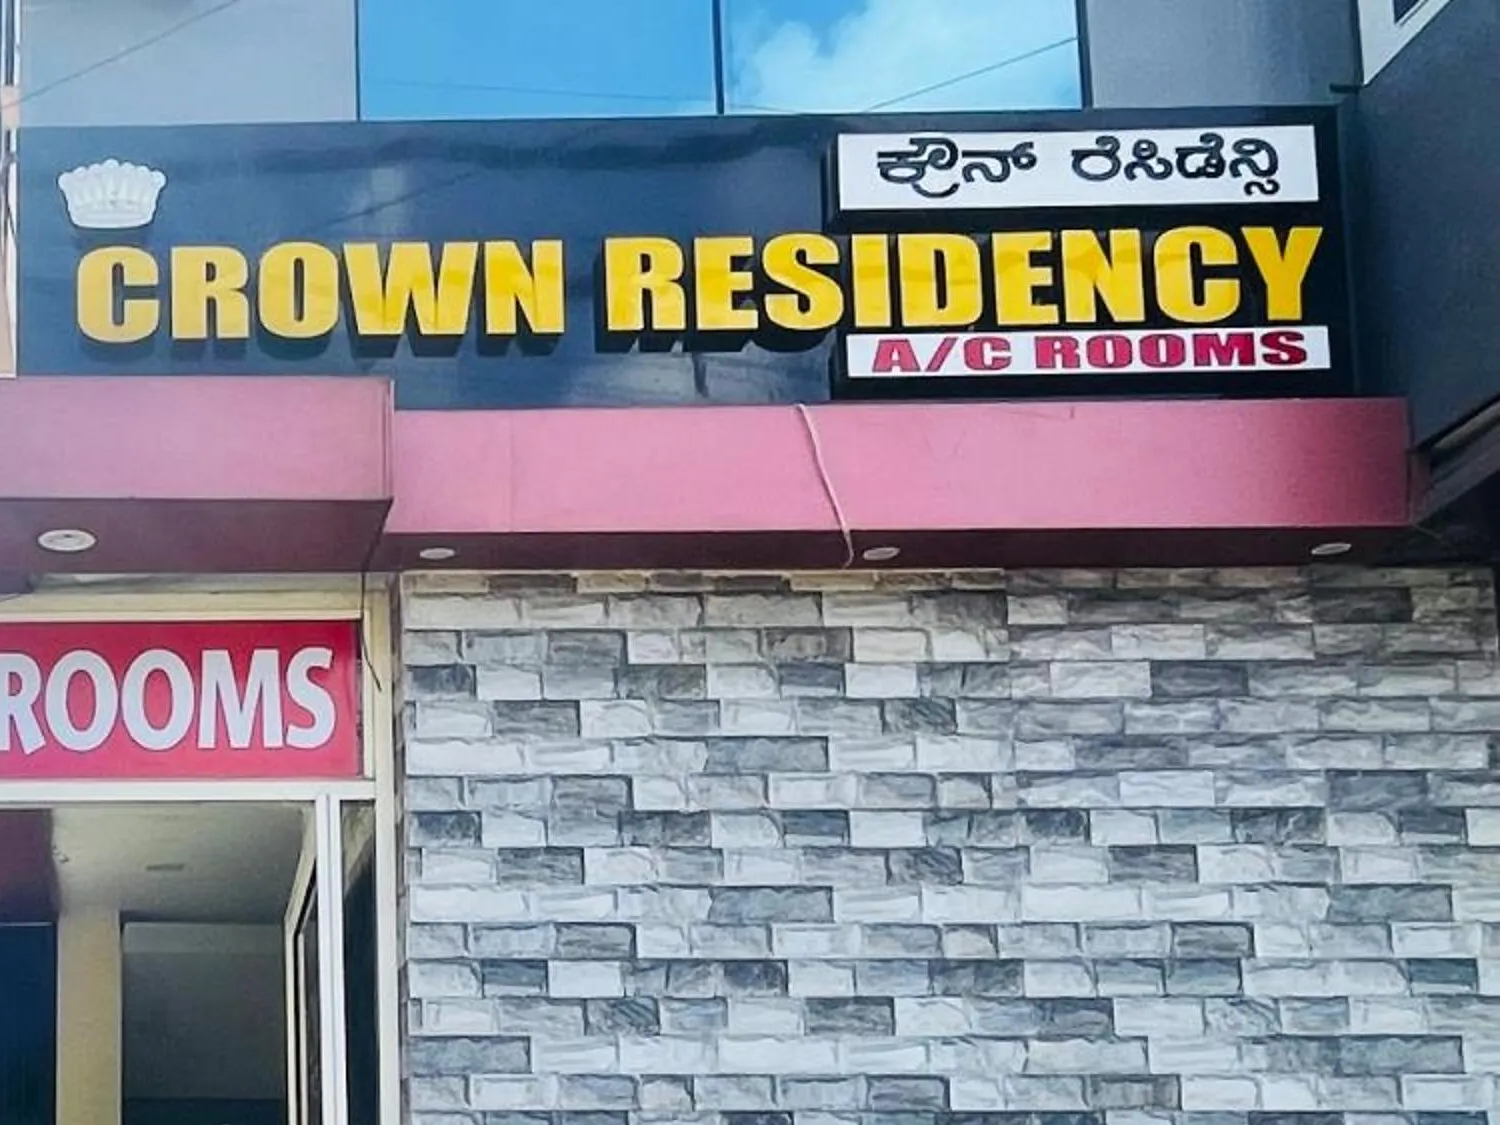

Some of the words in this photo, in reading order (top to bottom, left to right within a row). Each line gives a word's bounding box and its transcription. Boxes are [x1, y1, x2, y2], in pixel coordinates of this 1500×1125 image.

[876, 136, 1037, 199] ಕ್ರೌನ್
[1071, 132, 1281, 196] ರೆಸಿಡೆನ್ಸಿ
[75, 243, 563, 343] CROWN
[605, 226, 1323, 333] RESIDENCY
[871, 336, 1012, 373] A/C
[1034, 331, 1308, 369] ROOMS
